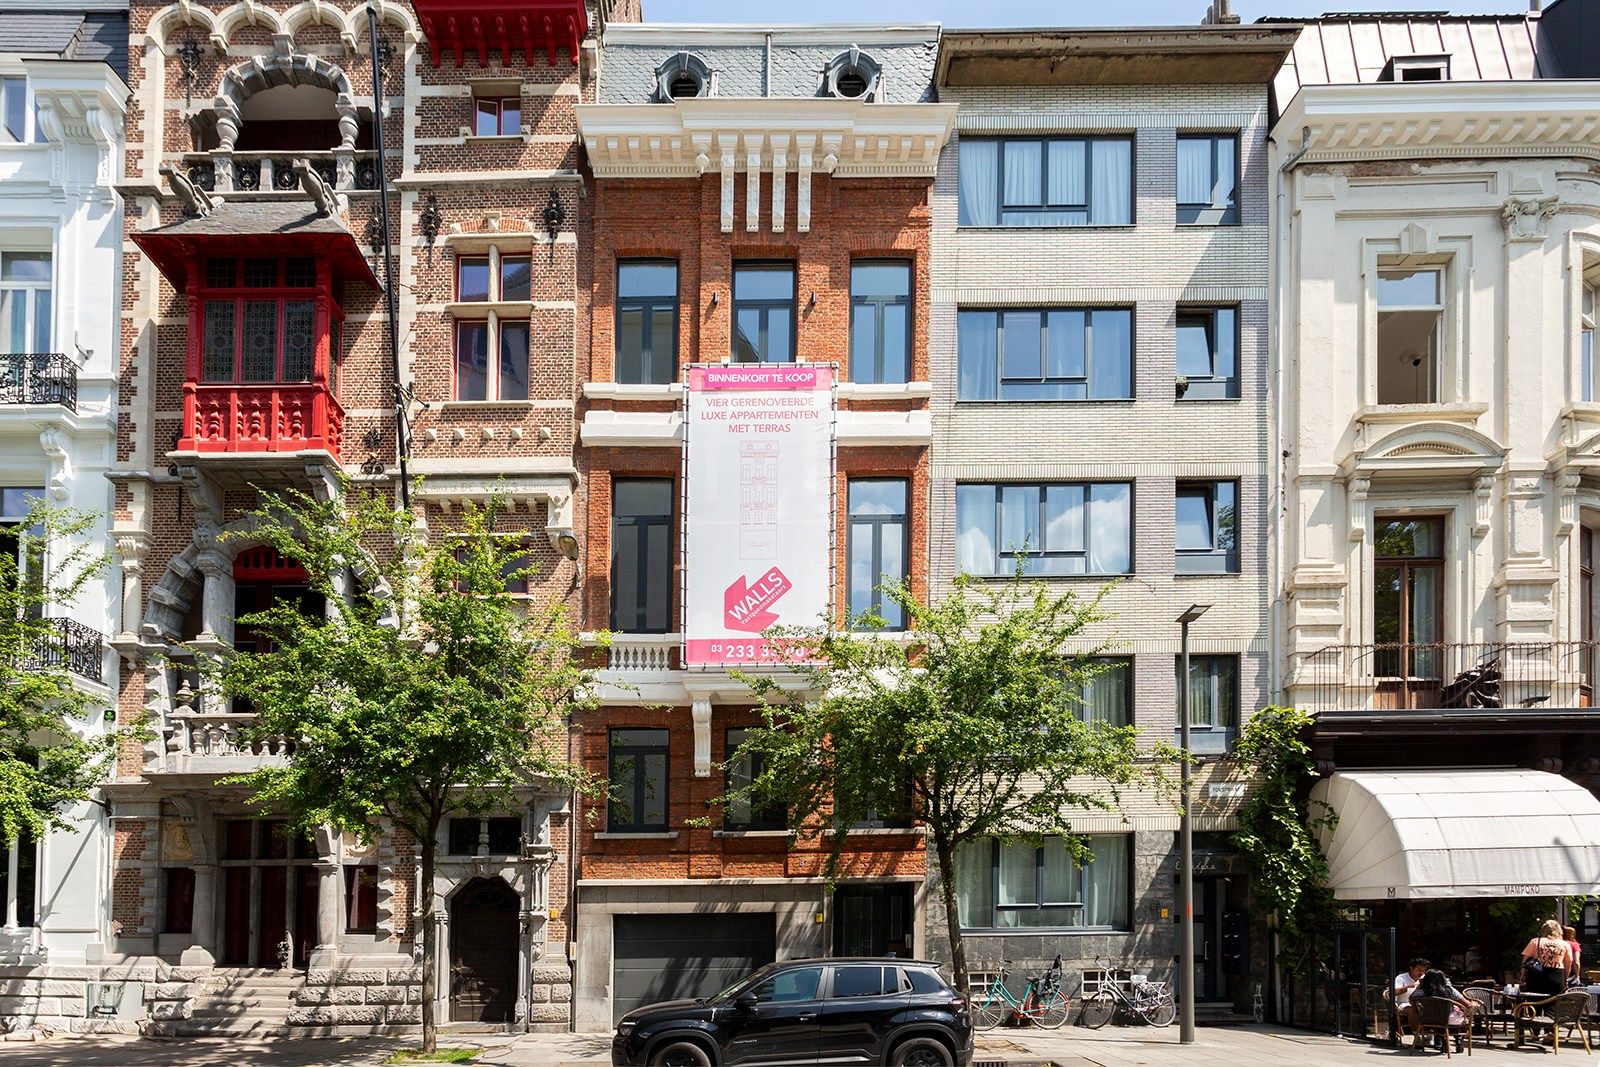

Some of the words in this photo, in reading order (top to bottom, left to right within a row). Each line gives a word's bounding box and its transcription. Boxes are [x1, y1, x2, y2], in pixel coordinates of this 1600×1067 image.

[708, 373, 771, 382] BINNENKORT
[772, 374, 784, 382] TE
[785, 373, 814, 382] KOOP
[706, 398, 728, 407] VIER
[731, 397, 814, 407] GERENOVEERDE
[701, 411, 727, 420] LUXE
[729, 410, 819, 420] APPARTEMENTEN
[728, 424, 751, 433] MET
[753, 424, 791, 433] TERRAS
[728, 572, 783, 621] WALLS
[711, 644, 723, 653] 03
[726, 645, 755, 658] 233
[1504, 884, 1540, 895] MAMPOKO
